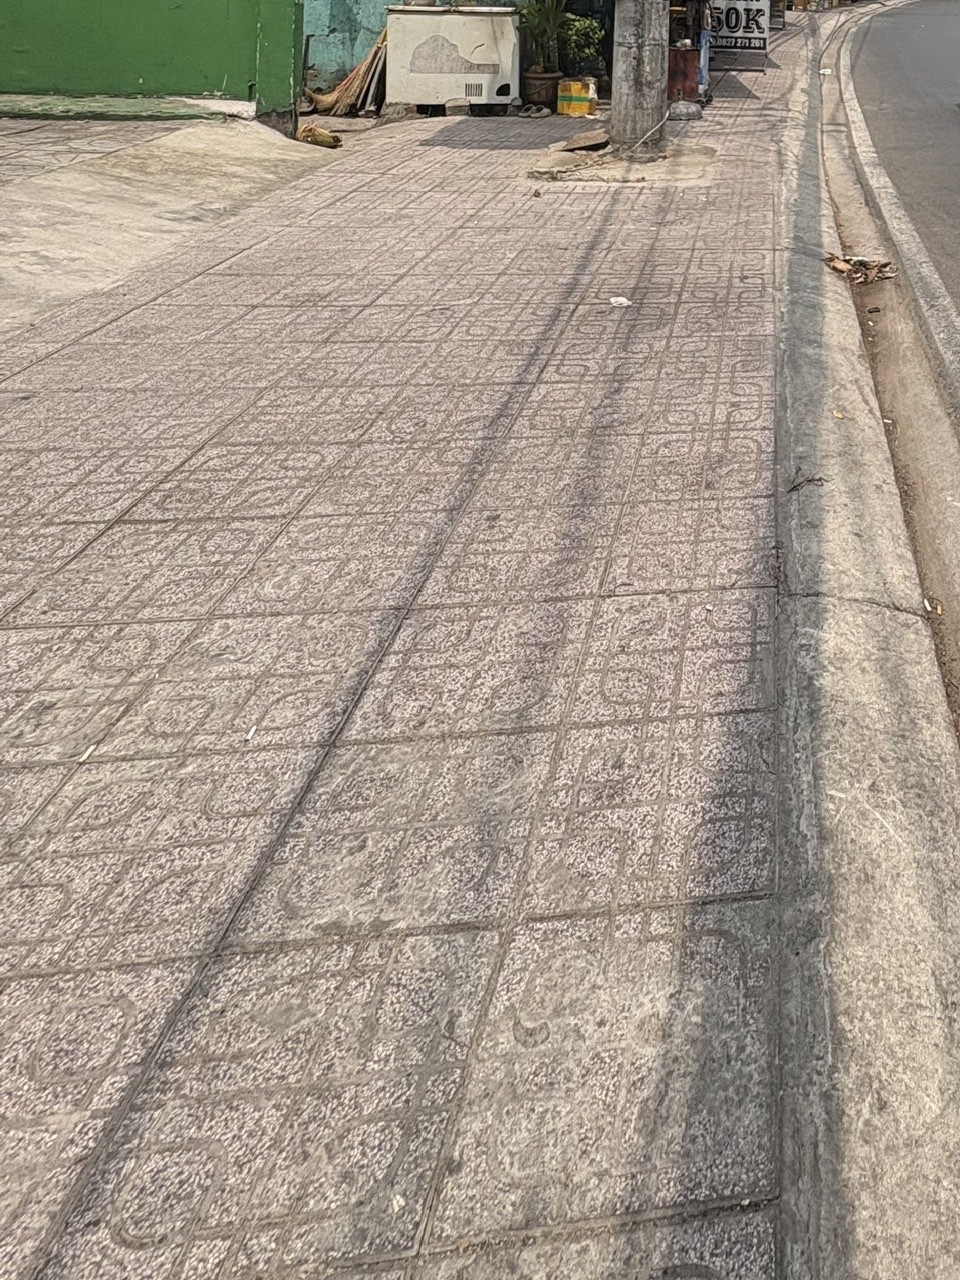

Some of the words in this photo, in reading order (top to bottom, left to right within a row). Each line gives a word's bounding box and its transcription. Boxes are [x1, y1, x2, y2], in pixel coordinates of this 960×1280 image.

[710, 7, 765, 34] 50K
[736, 39, 749, 47] 271
[750, 40, 764, 48] 261
